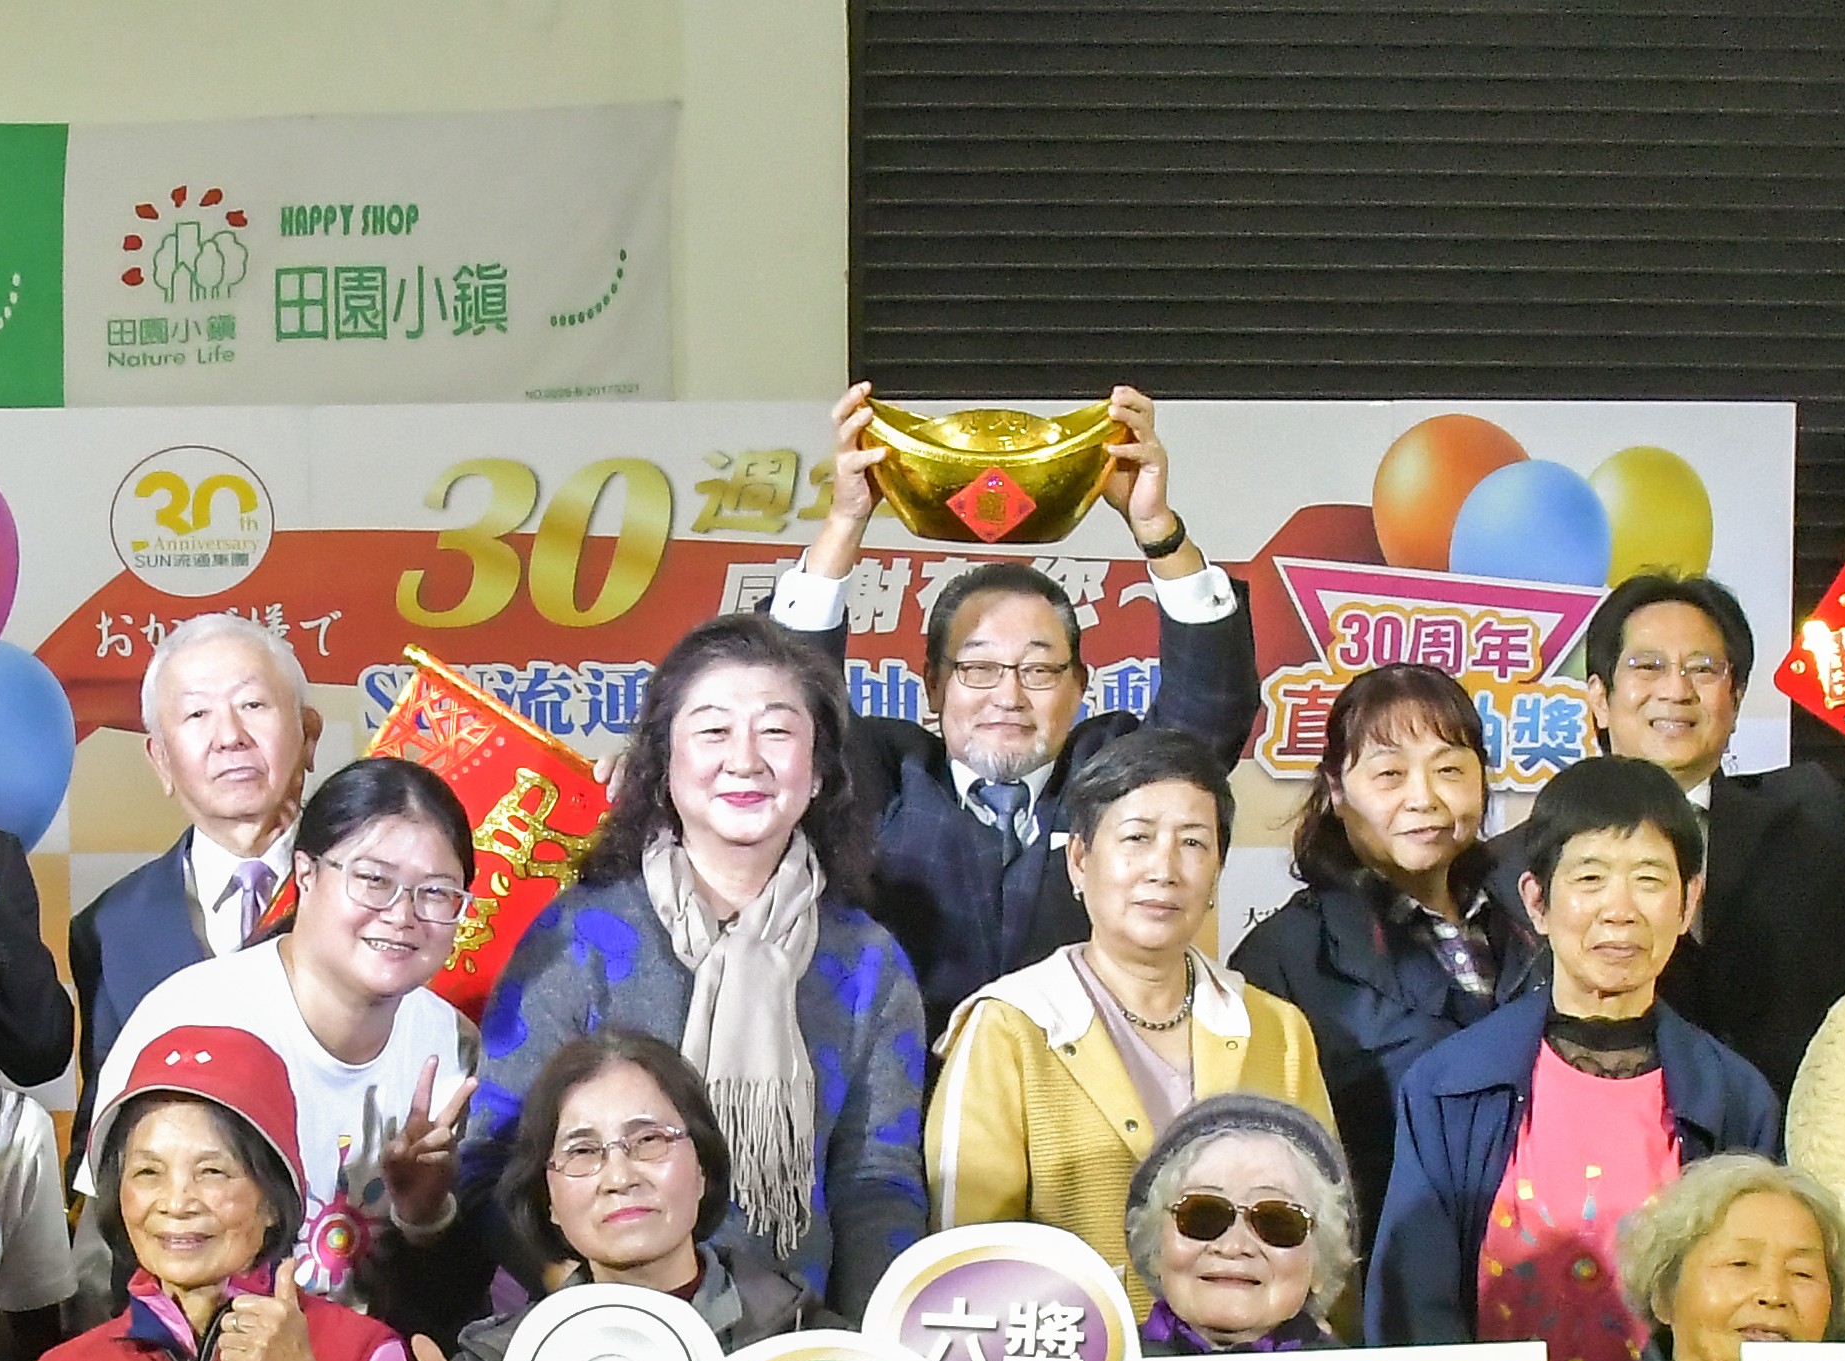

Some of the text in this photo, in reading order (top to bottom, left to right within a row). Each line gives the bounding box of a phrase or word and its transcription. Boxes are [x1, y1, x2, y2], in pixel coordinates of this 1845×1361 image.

[281, 203, 420, 236] HAPPY SHOP
[275, 263, 508, 343] 田園小鎮
[106, 313, 237, 347] 田園小鎮
[107, 346, 236, 369] Nature Life
[153, 536, 260, 553] Anniversary
[1338, 611, 1534, 678] 30周年
